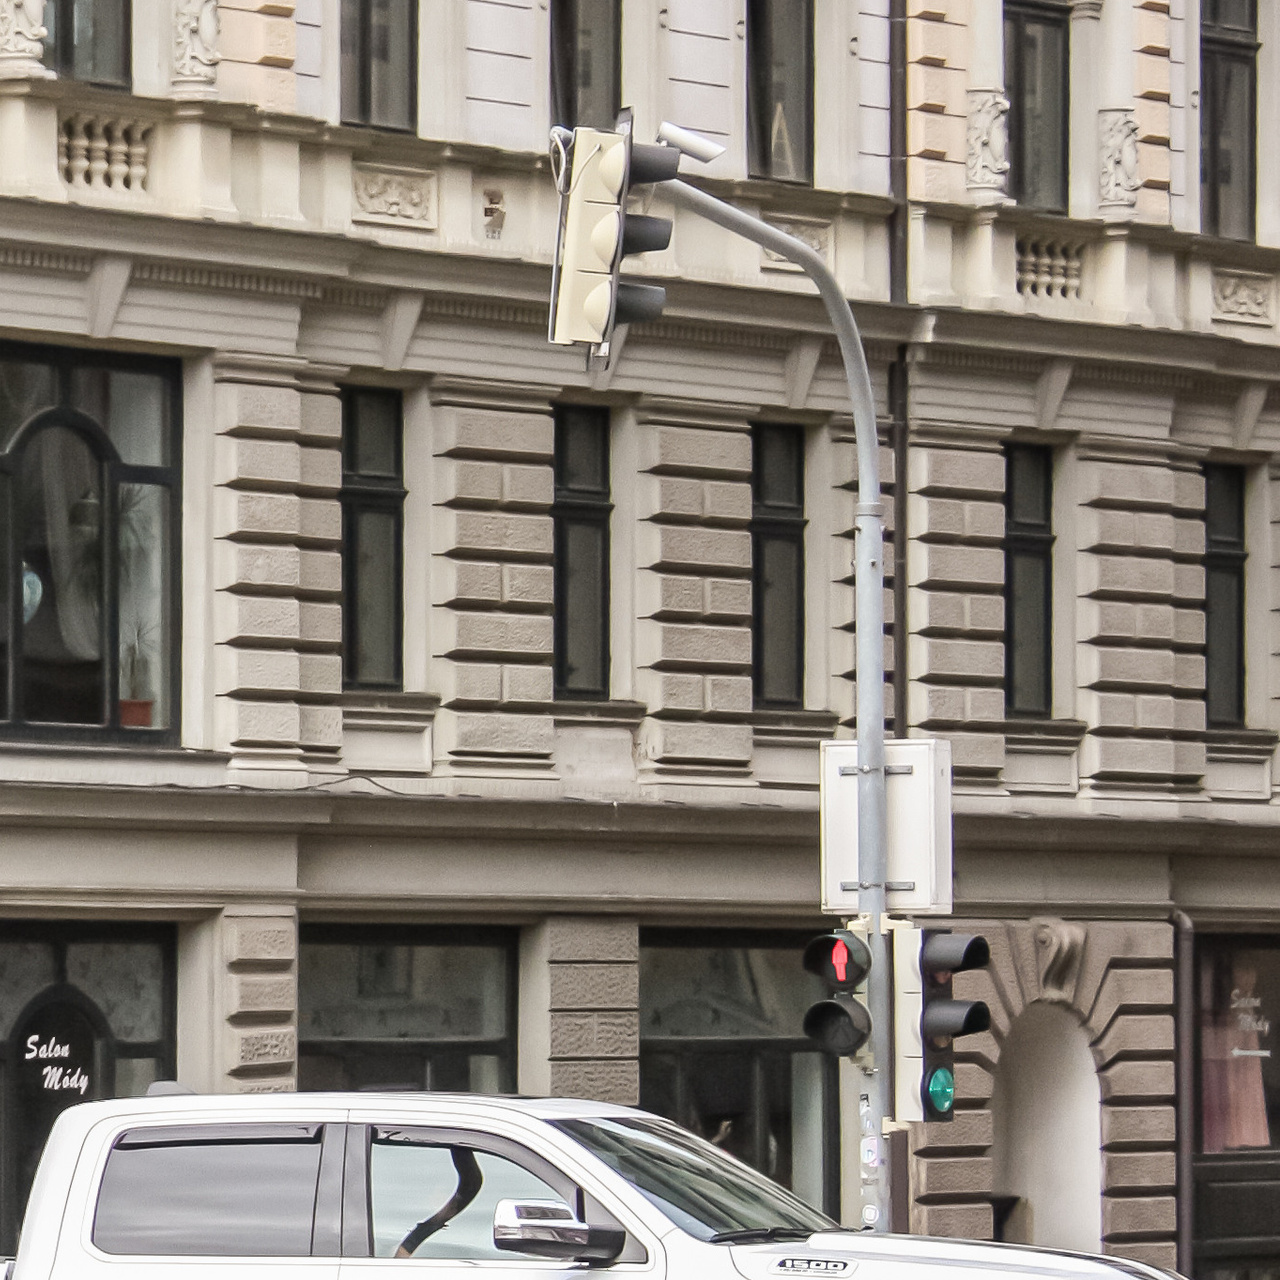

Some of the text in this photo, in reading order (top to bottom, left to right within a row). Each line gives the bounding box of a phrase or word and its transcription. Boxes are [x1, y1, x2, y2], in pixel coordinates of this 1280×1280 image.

[24, 1034, 71, 1060] Salon
[42, 1065, 89, 1095] Módy
[784, 1259, 846, 1271] 1500
